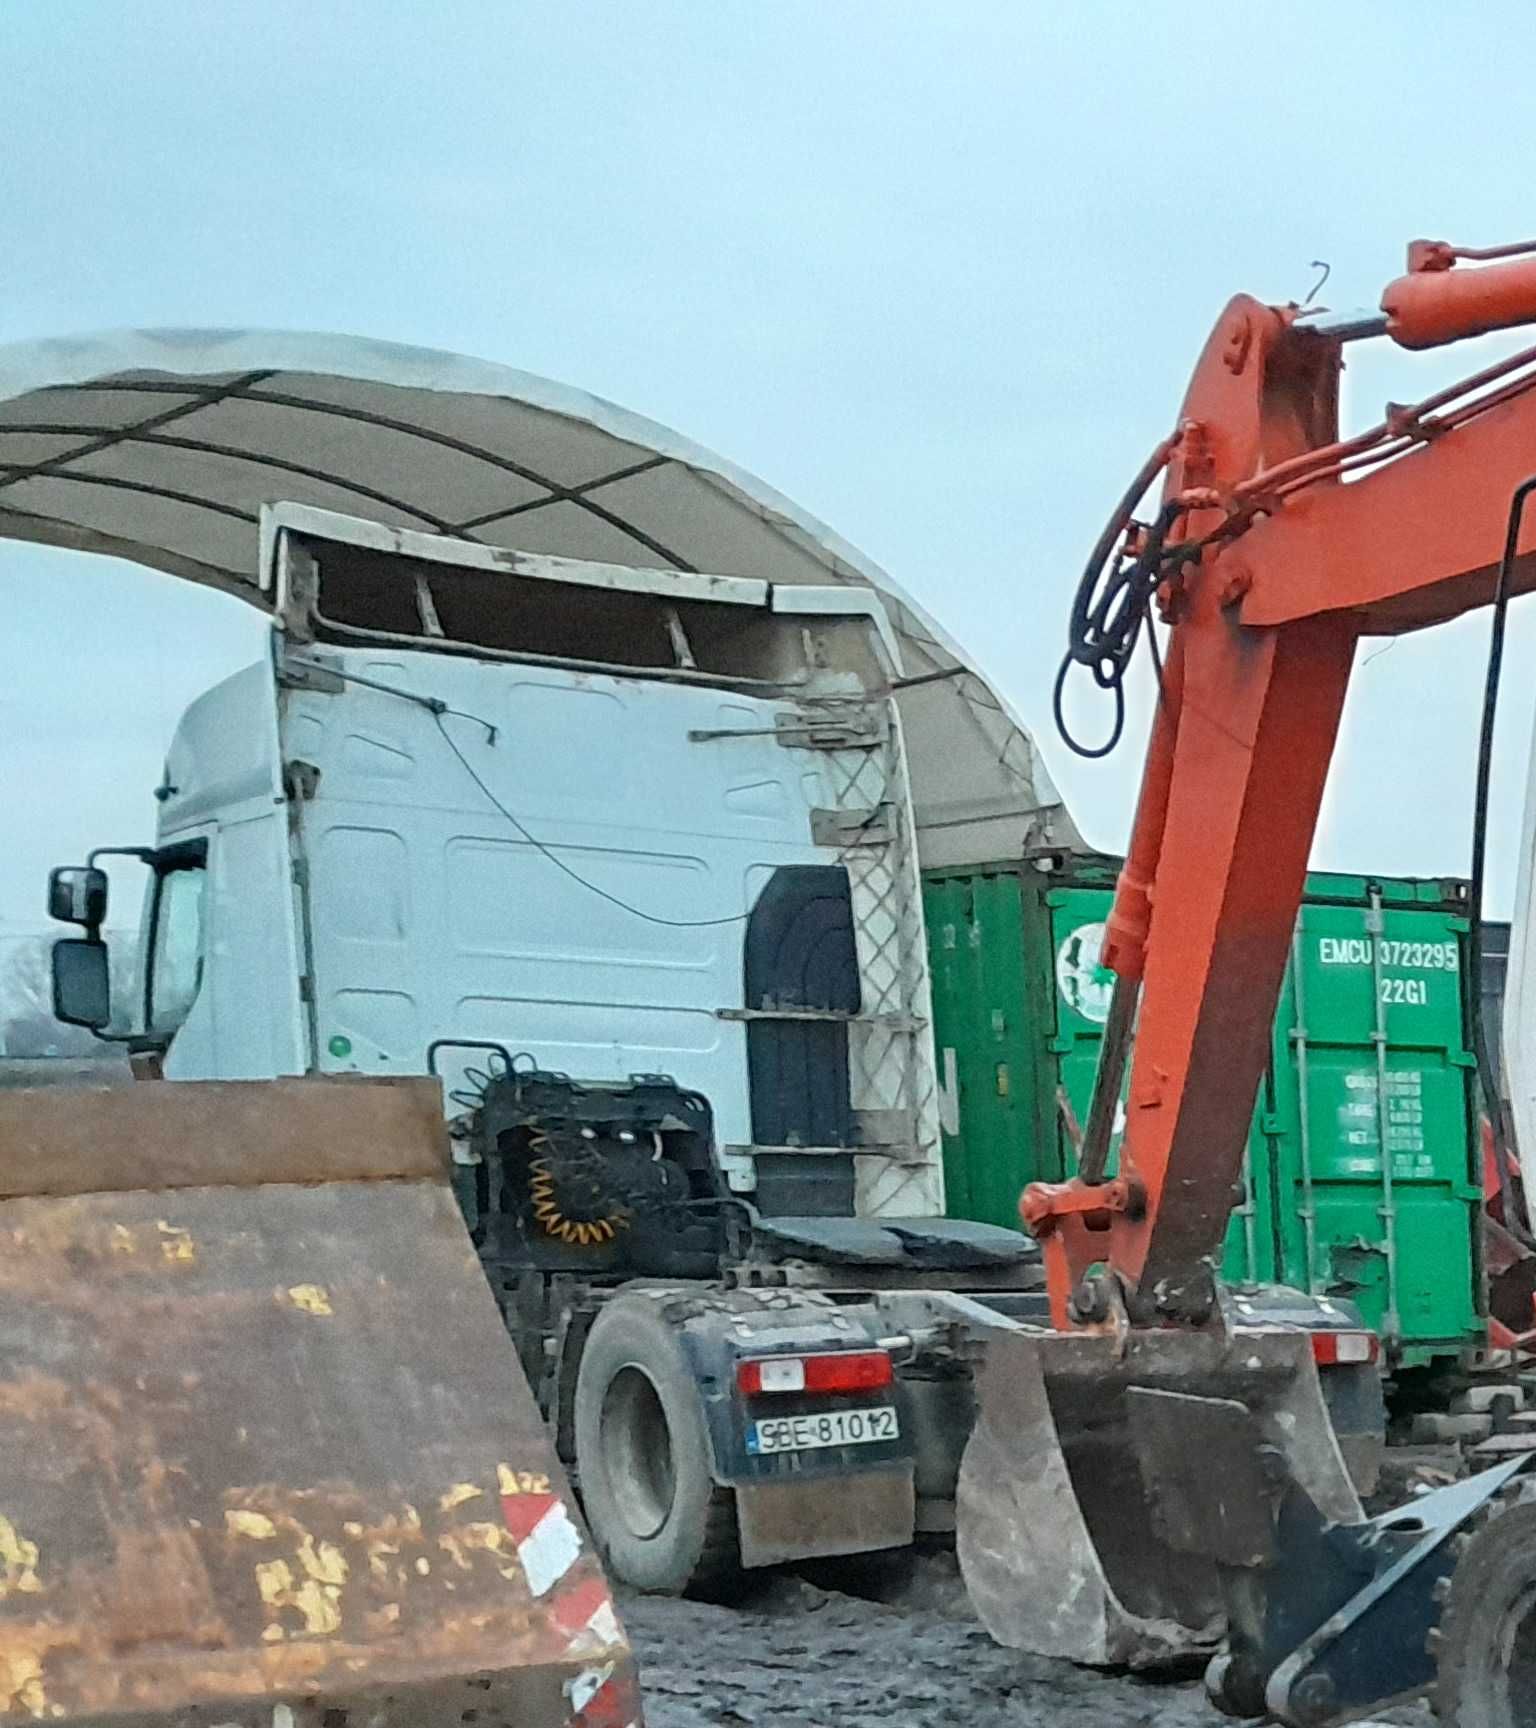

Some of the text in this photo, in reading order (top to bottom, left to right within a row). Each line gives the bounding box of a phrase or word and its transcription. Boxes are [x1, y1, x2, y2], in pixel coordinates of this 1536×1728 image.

[1319, 938, 1373, 964] EMCU
[760, 1410, 895, 1449] SBE 81012
